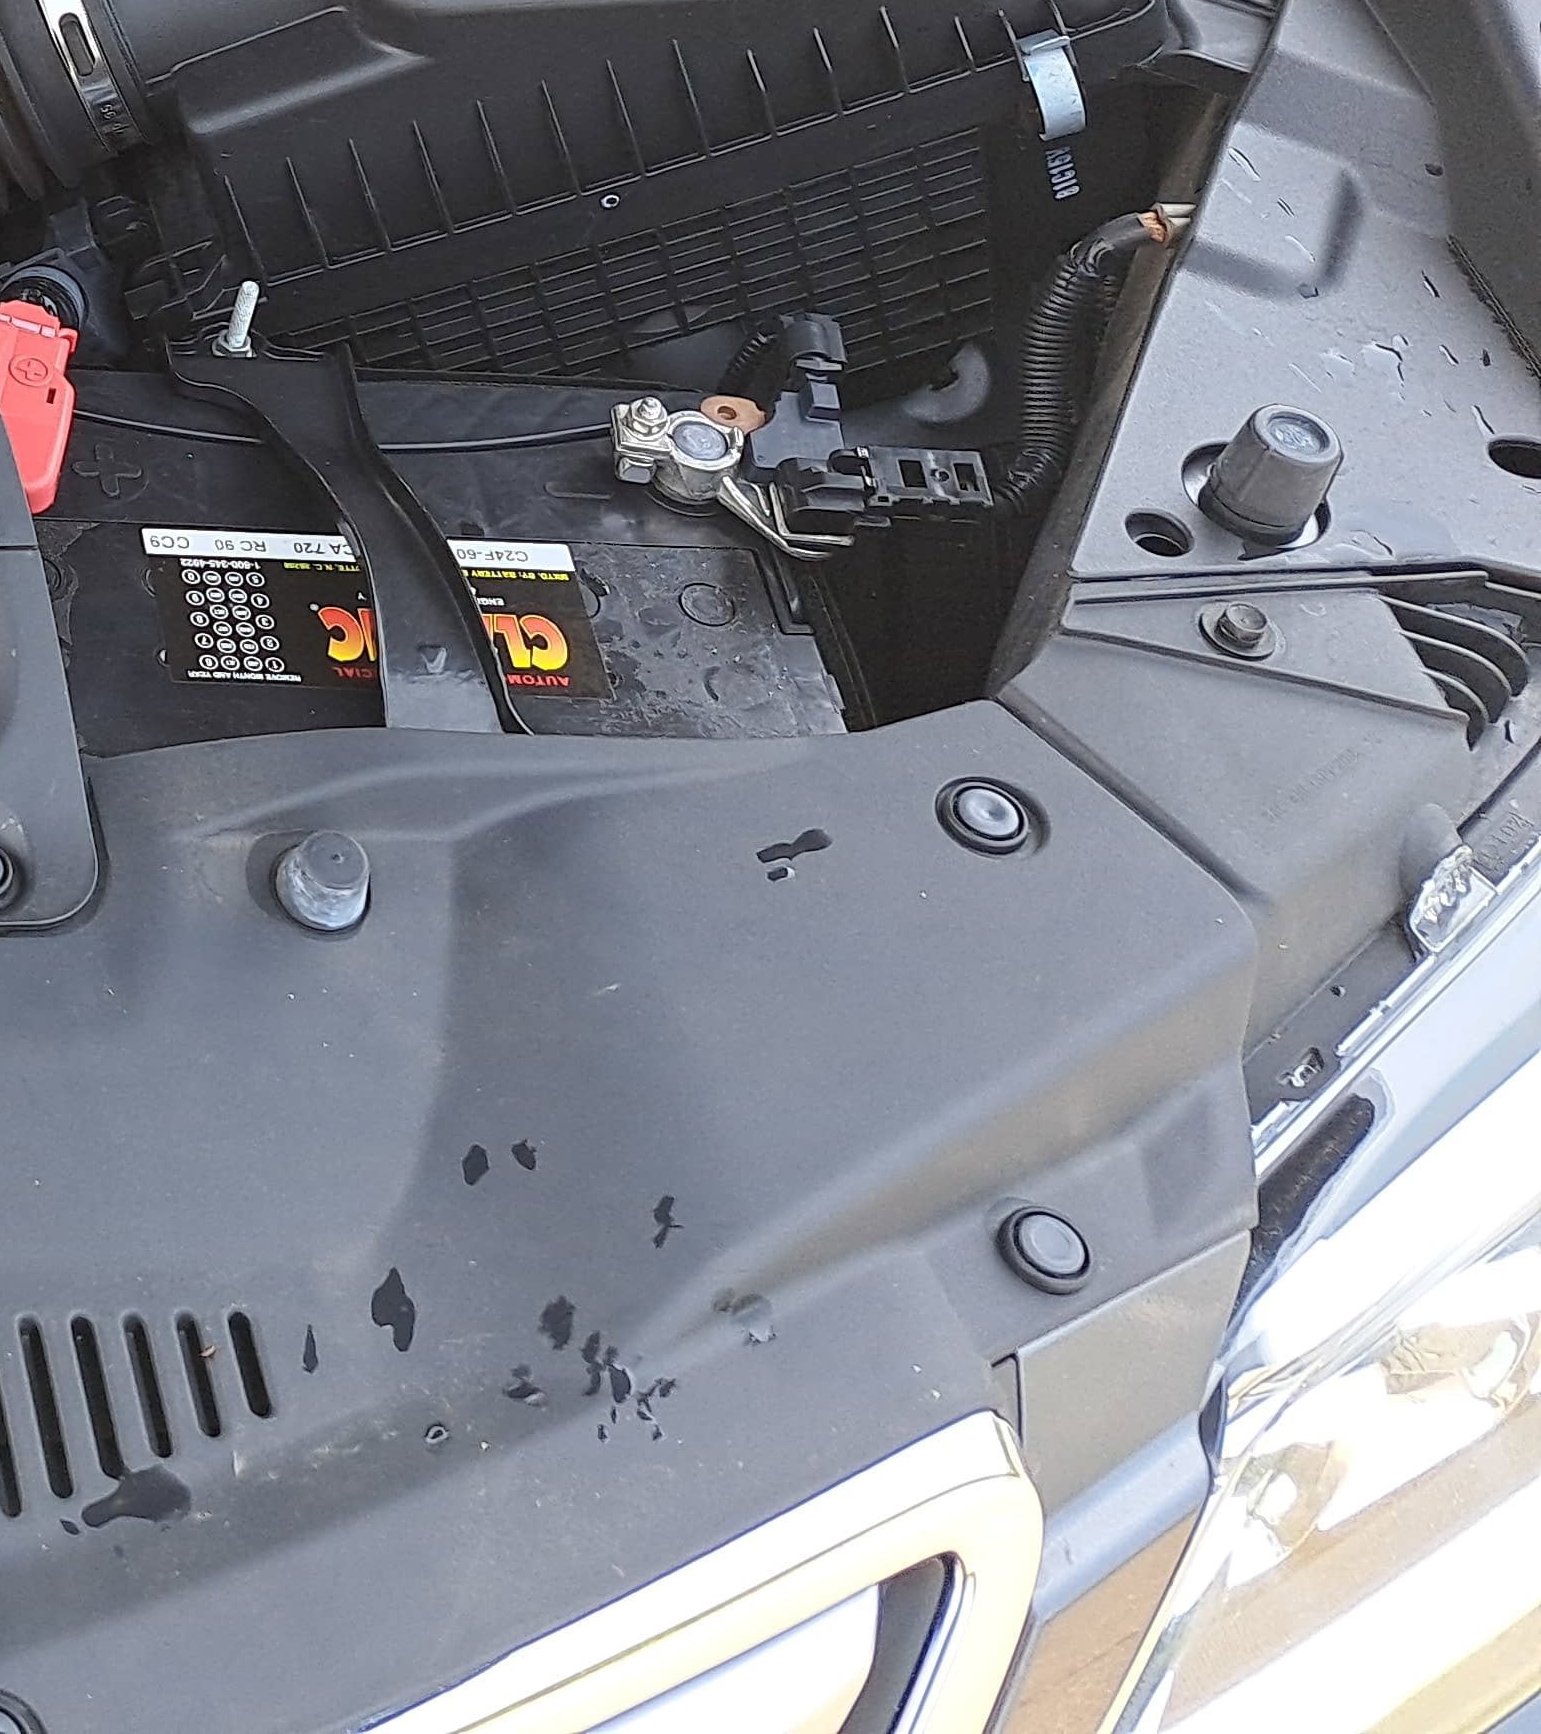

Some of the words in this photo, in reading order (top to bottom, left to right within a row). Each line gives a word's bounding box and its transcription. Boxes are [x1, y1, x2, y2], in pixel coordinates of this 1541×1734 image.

[215, 538, 235, 551] 90
[240, 540, 266, 552] RC
[294, 542, 323, 554] 720
[457, 548, 528, 562] C24F-60
